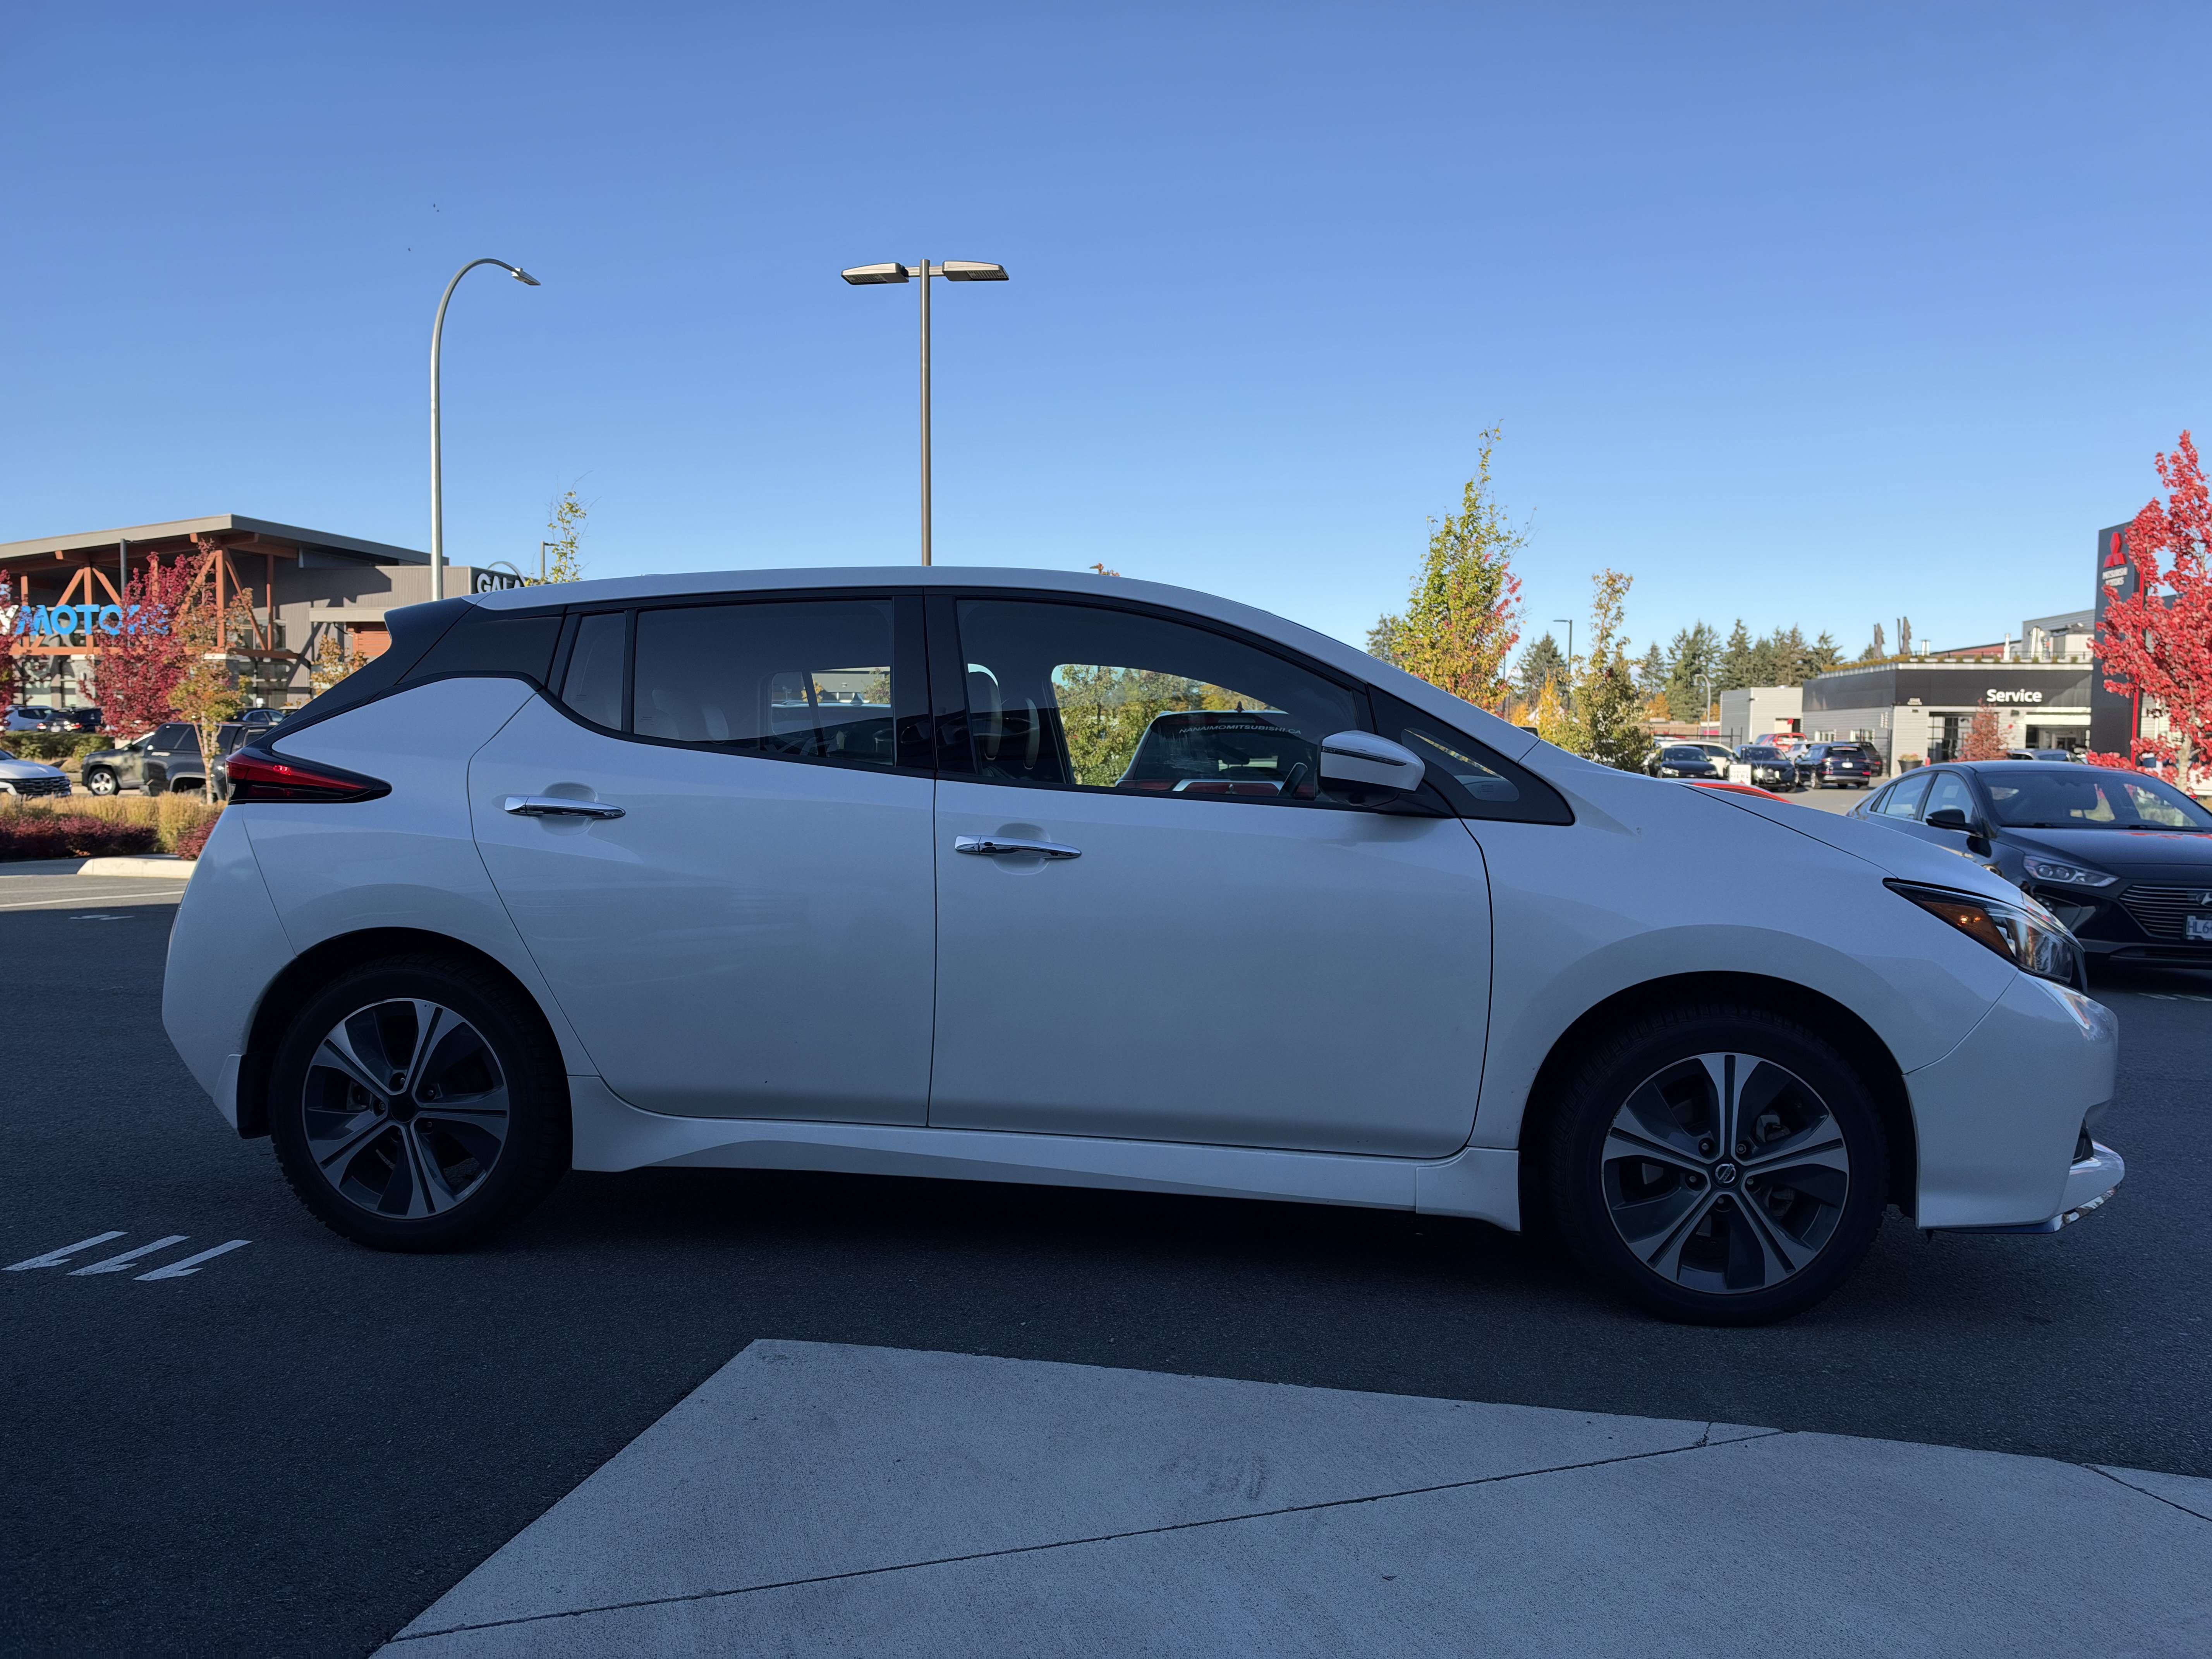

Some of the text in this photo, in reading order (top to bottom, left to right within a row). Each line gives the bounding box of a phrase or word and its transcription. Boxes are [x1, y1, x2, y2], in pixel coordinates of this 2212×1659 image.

[1986, 689, 2042, 702] Service
[1179, 725, 1301, 735] NANAIMOMITSUBISHI.CA
[2187, 921, 2212, 934] HL6
